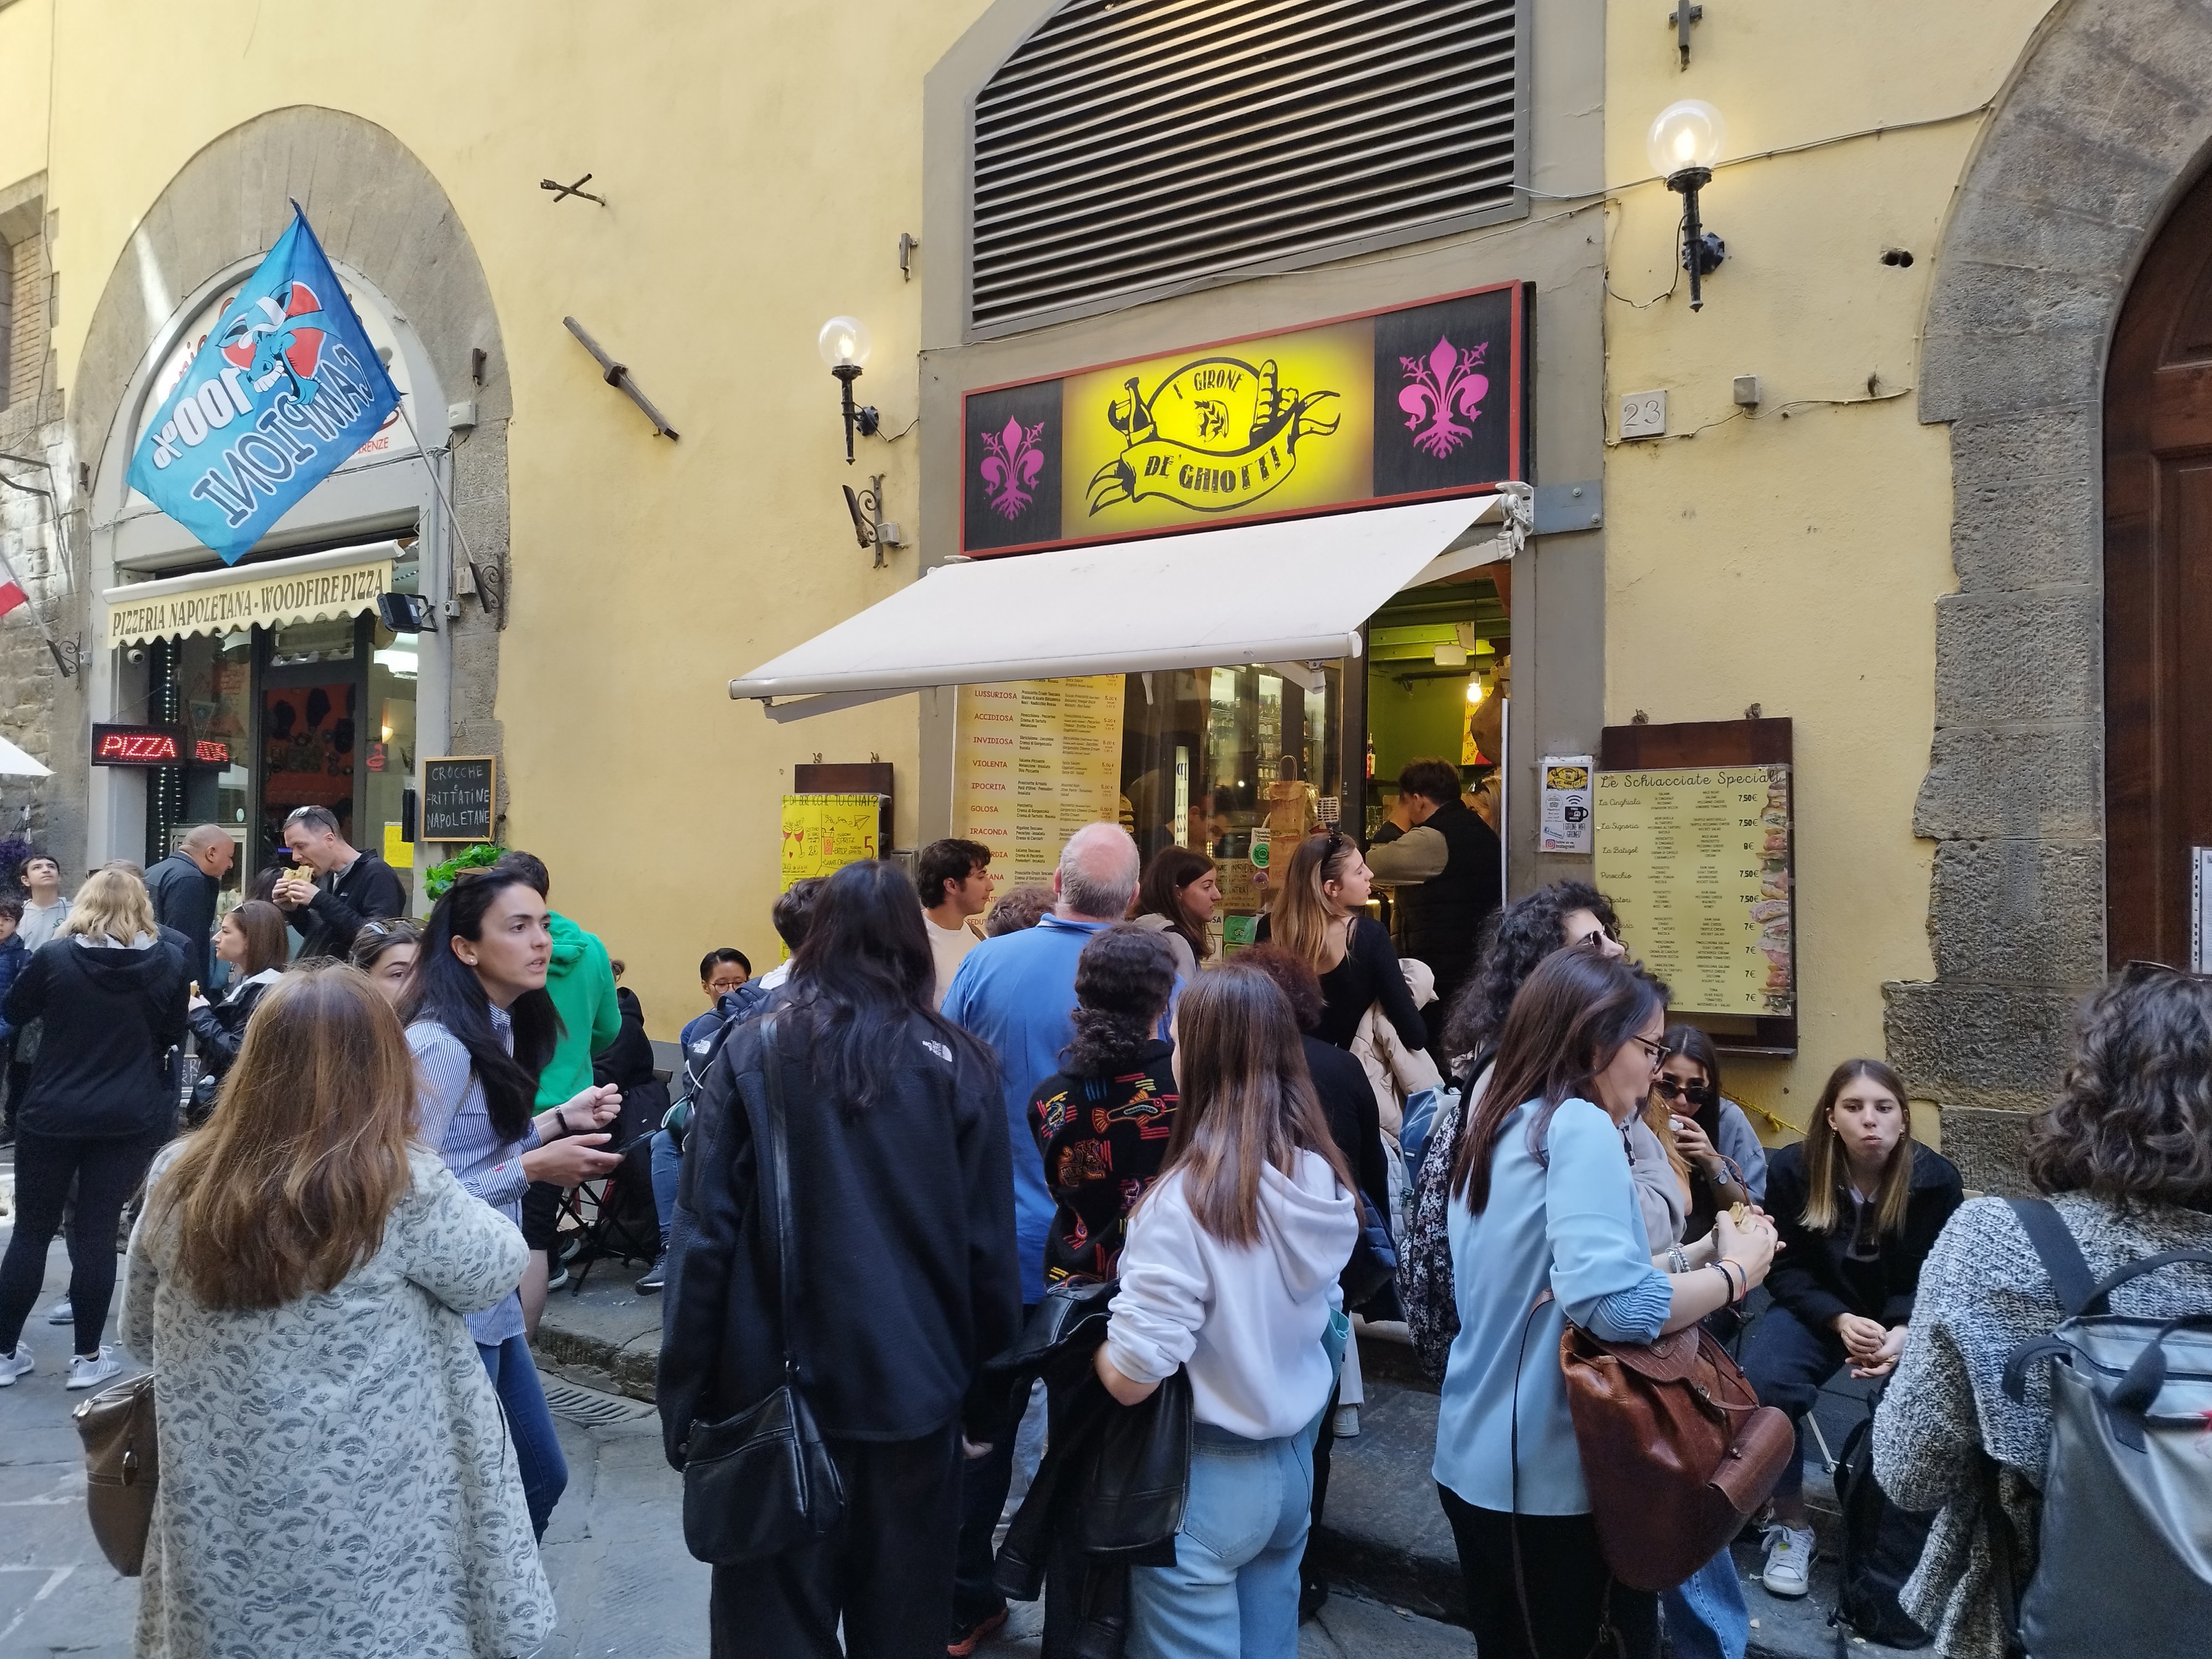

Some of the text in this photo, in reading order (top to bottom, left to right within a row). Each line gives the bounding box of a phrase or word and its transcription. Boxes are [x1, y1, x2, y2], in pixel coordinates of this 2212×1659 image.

[1193, 369, 1245, 393] GIRONE
[1624, 400, 1660, 427] 23
[357, 436, 389, 454] IRENZE
[1178, 445, 1281, 494] GHIOTTI
[112, 604, 165, 637] PIZZERIA
[168, 590, 252, 628] NAPOLETANA
[261, 575, 340, 613] WOODFIRE
[341, 568, 384, 601] PIZZA
[975, 690, 1017, 700] LUSSURIOSA
[974, 713, 1014, 722] ACCIDIOSA
[101, 736, 176, 758] PIZZA
[973, 737, 1013, 745] INVIDIOSA
[1463, 747, 1478, 764] HEAVE
[432, 765, 483, 781] CROCCHE
[1600, 769, 1782, 788] Le Schiacciate Speciali
[835, 795, 844, 806] TU
[1610, 798, 1641, 807] Cinghiala
[427, 808, 489, 831] NAPOLETANE
[1611, 822, 1639, 831] Signoria
[1613, 846, 1639, 855] Batigol
